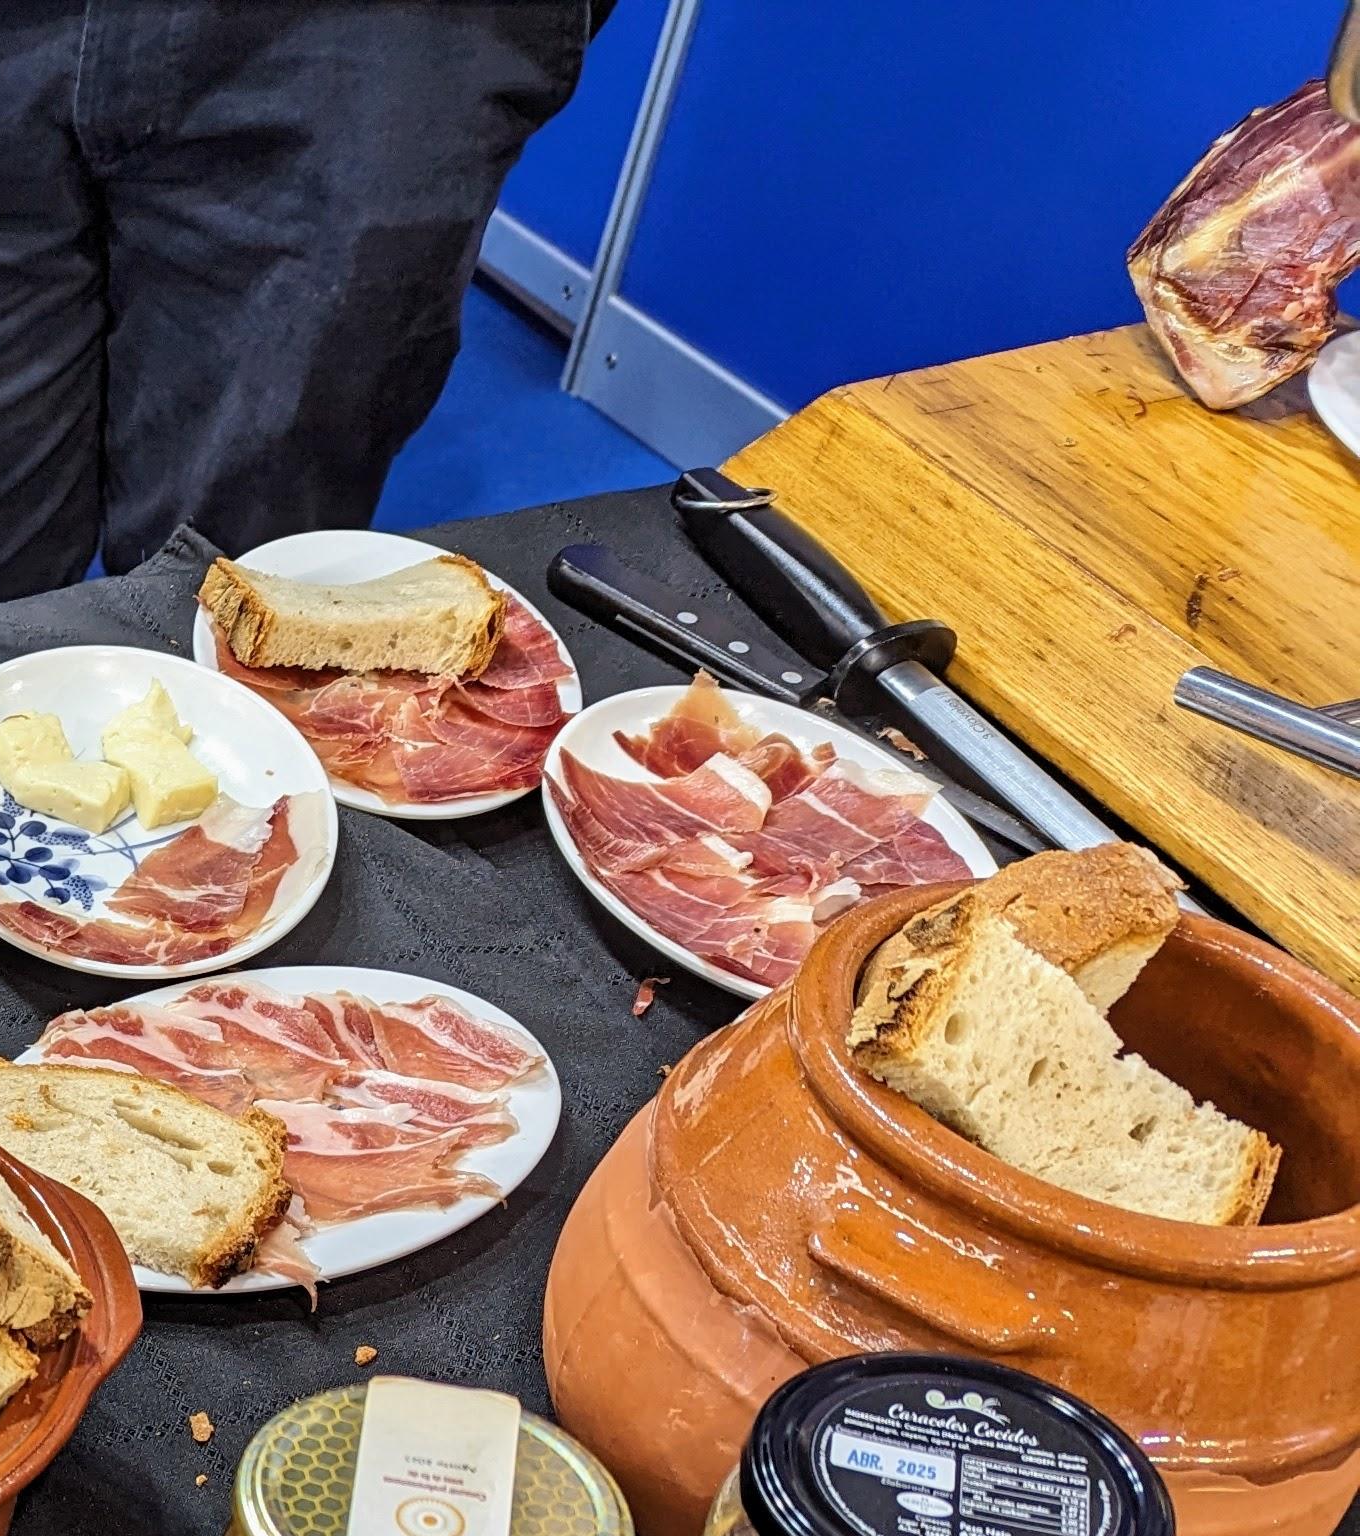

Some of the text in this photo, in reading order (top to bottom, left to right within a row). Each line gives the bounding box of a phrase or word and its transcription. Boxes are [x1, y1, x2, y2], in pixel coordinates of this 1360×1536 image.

[888, 1403, 968, 1434] Caracoles
[973, 1421, 1039, 1448] Cocidos
[896, 1458, 937, 1480] 2025
